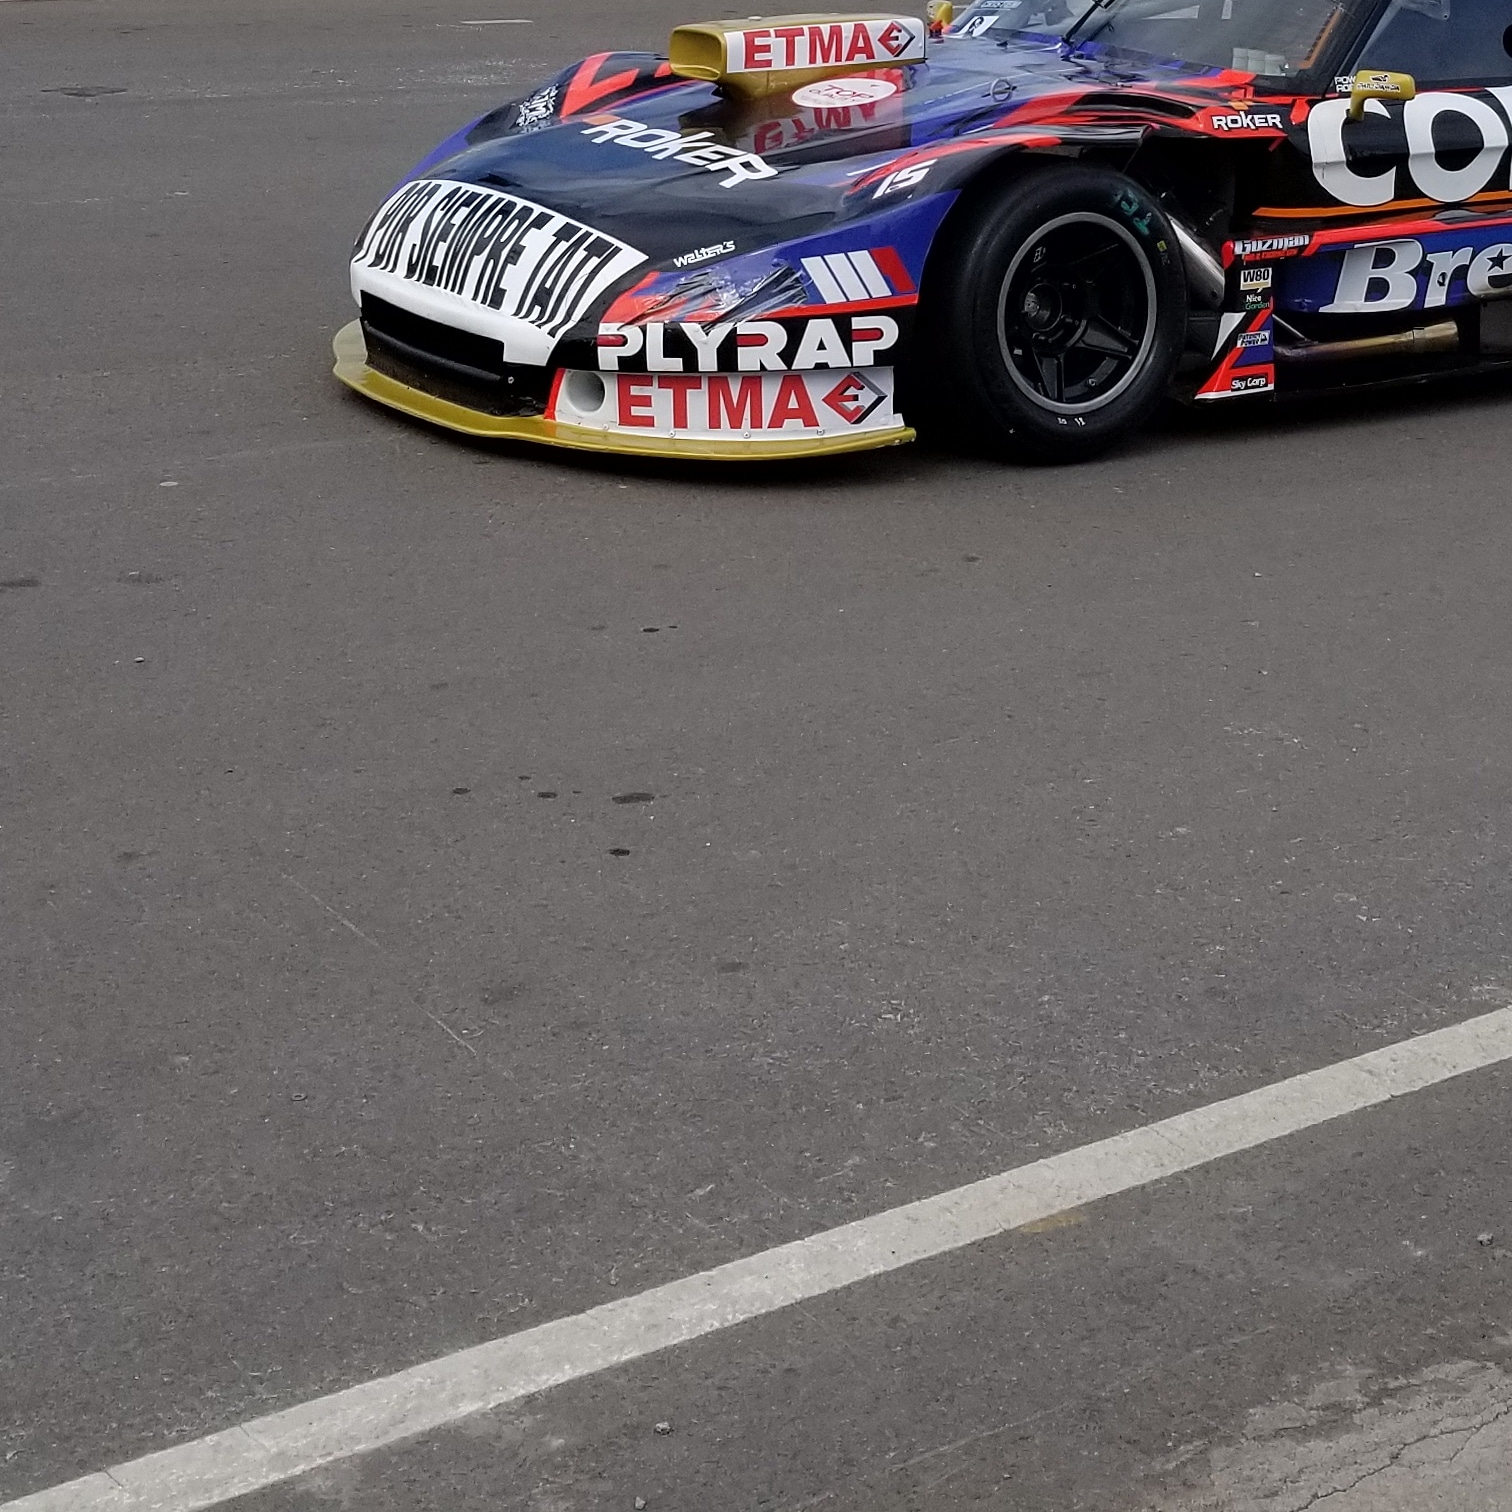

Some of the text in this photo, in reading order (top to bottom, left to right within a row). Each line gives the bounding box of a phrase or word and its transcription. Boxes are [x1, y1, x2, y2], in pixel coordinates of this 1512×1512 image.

[743, 22, 876, 69] ETMA
[1212, 113, 1284, 130] ROKER
[581, 118, 779, 188] ROKER
[404, 185, 555, 311] SIEMPRE
[511, 221, 624, 339] TATI
[1243, 268, 1270, 283] W80
[597, 316, 899, 373] PLYRAP
[616, 374, 821, 430] ETMA
[1231, 377, 1266, 390] Sky Corp
